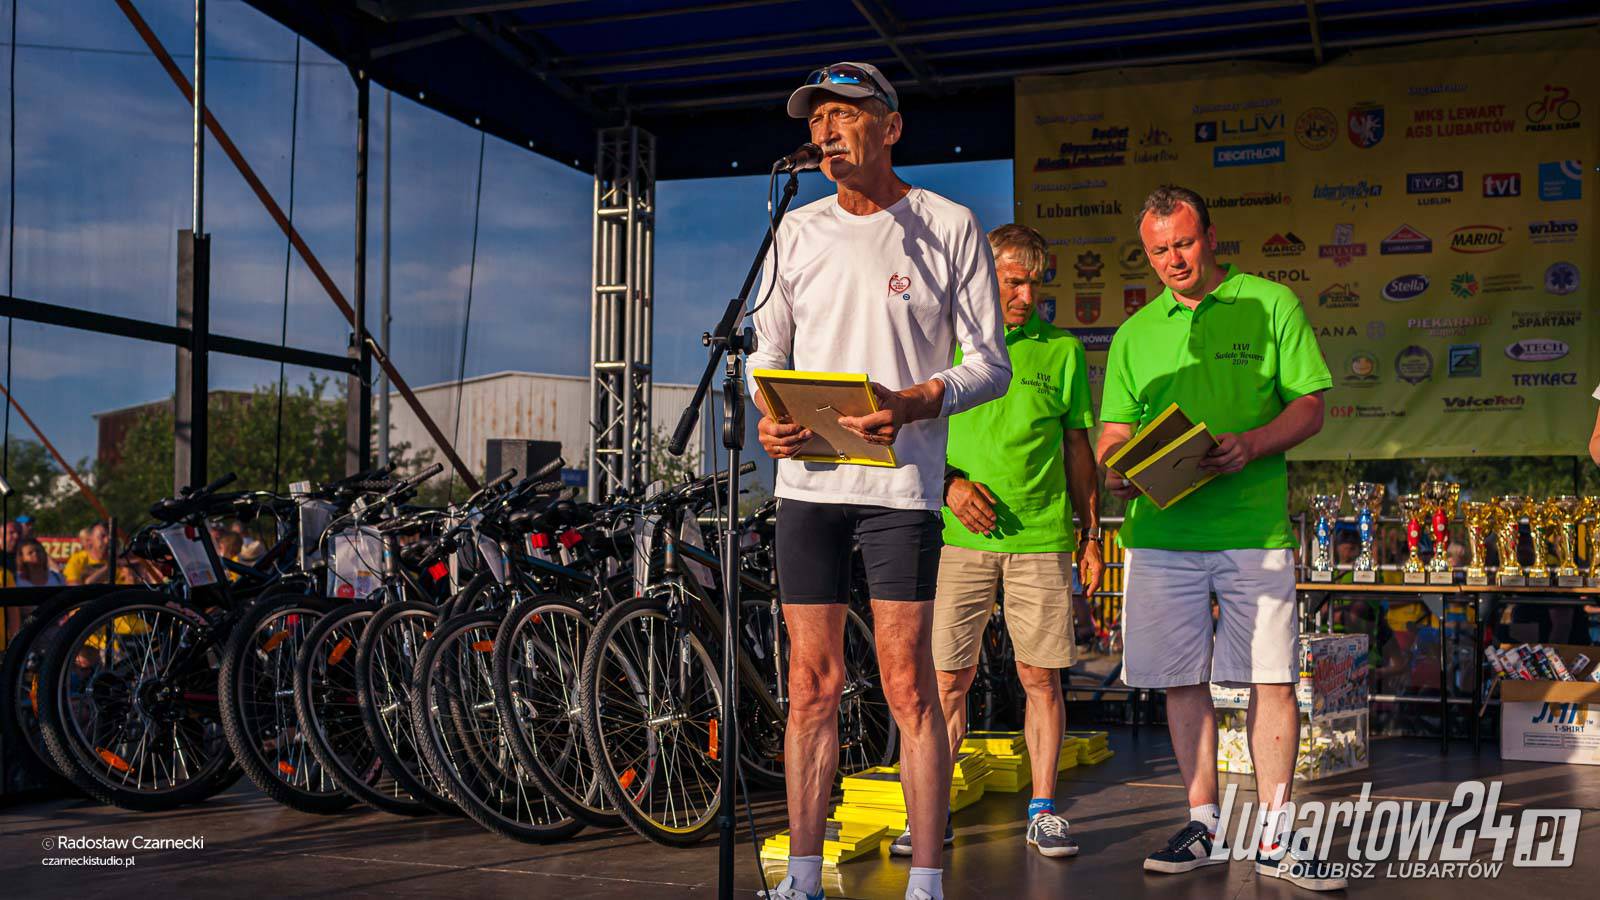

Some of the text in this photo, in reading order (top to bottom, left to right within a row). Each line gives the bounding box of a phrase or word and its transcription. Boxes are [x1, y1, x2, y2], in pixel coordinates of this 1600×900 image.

[1414, 104, 1506, 122] MKS LEWART
[1406, 124, 1433, 139] AGS
[1218, 147, 1281, 162] DECATHLON
[1418, 197, 1451, 206] LUBLIN
[1036, 200, 1122, 218] Lubartowiak
[1529, 221, 1578, 234] wibro
[1451, 232, 1505, 246] MARIOL
[1390, 279, 1425, 293] Stella
[1524, 344, 1564, 353] TECH
[1512, 373, 1577, 387] TRYKACZ
[1442, 395, 1525, 408] VoiceTech
[1331, 405, 1354, 417] OSP
[1554, 725, 1584, 733] T-SHIRT
